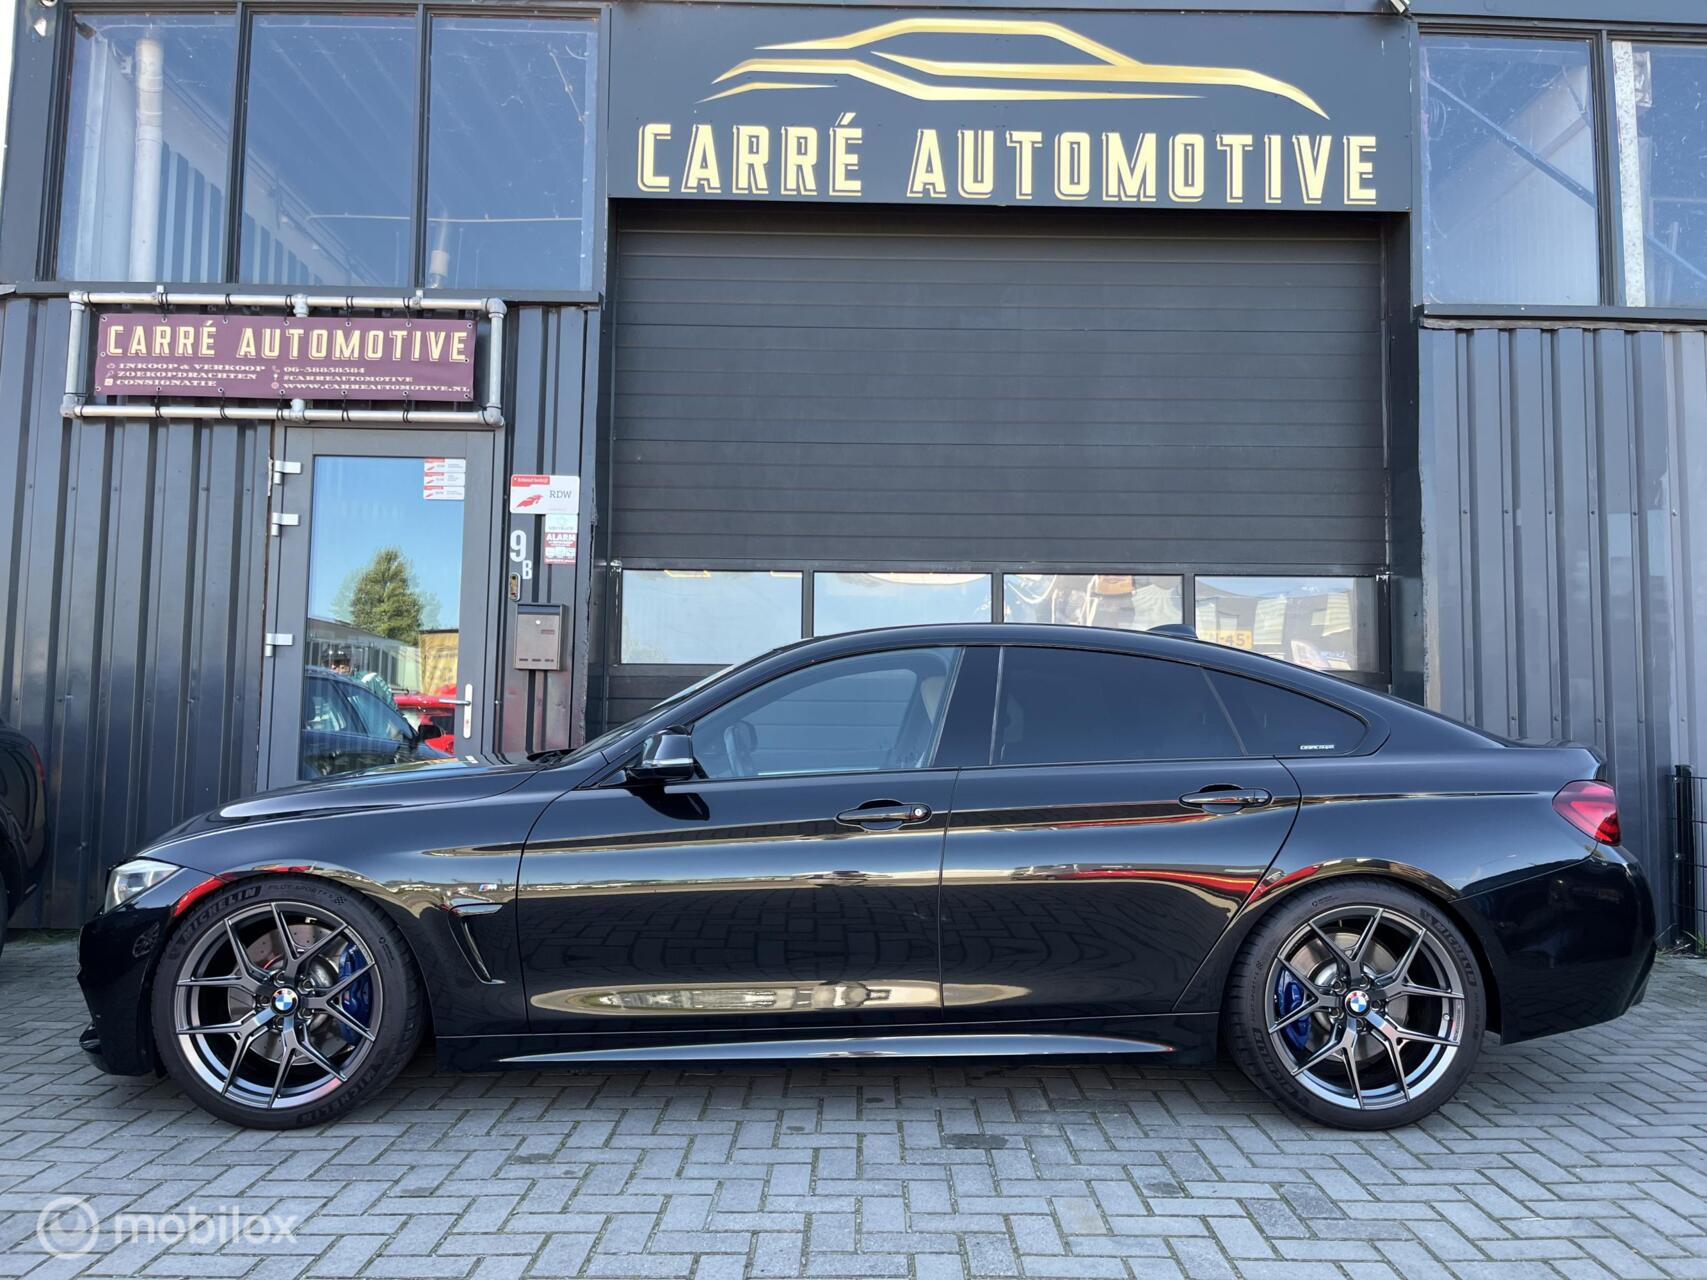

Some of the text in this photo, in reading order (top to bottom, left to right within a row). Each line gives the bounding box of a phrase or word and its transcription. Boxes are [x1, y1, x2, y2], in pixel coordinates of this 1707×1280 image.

[637, 112, 1378, 206] CARRÉ AUTOMOTIVE
[105, 320, 469, 363] CARRÉ AUTOMOTIVE
[116, 370, 257, 380] ZOEKOPDRACHTEN
[118, 362, 178, 370] INKOOP
[193, 364, 267, 372] VERKOOP
[115, 378, 217, 387] CONSIGNATIE
[549, 489, 572, 499] RDW
[510, 530, 527, 562] 9
[546, 533, 576, 542] ALARM
[522, 560, 533, 580] B
[182, 887, 257, 941] MICHELIN
[1434, 919, 1477, 984] MICHELIN
